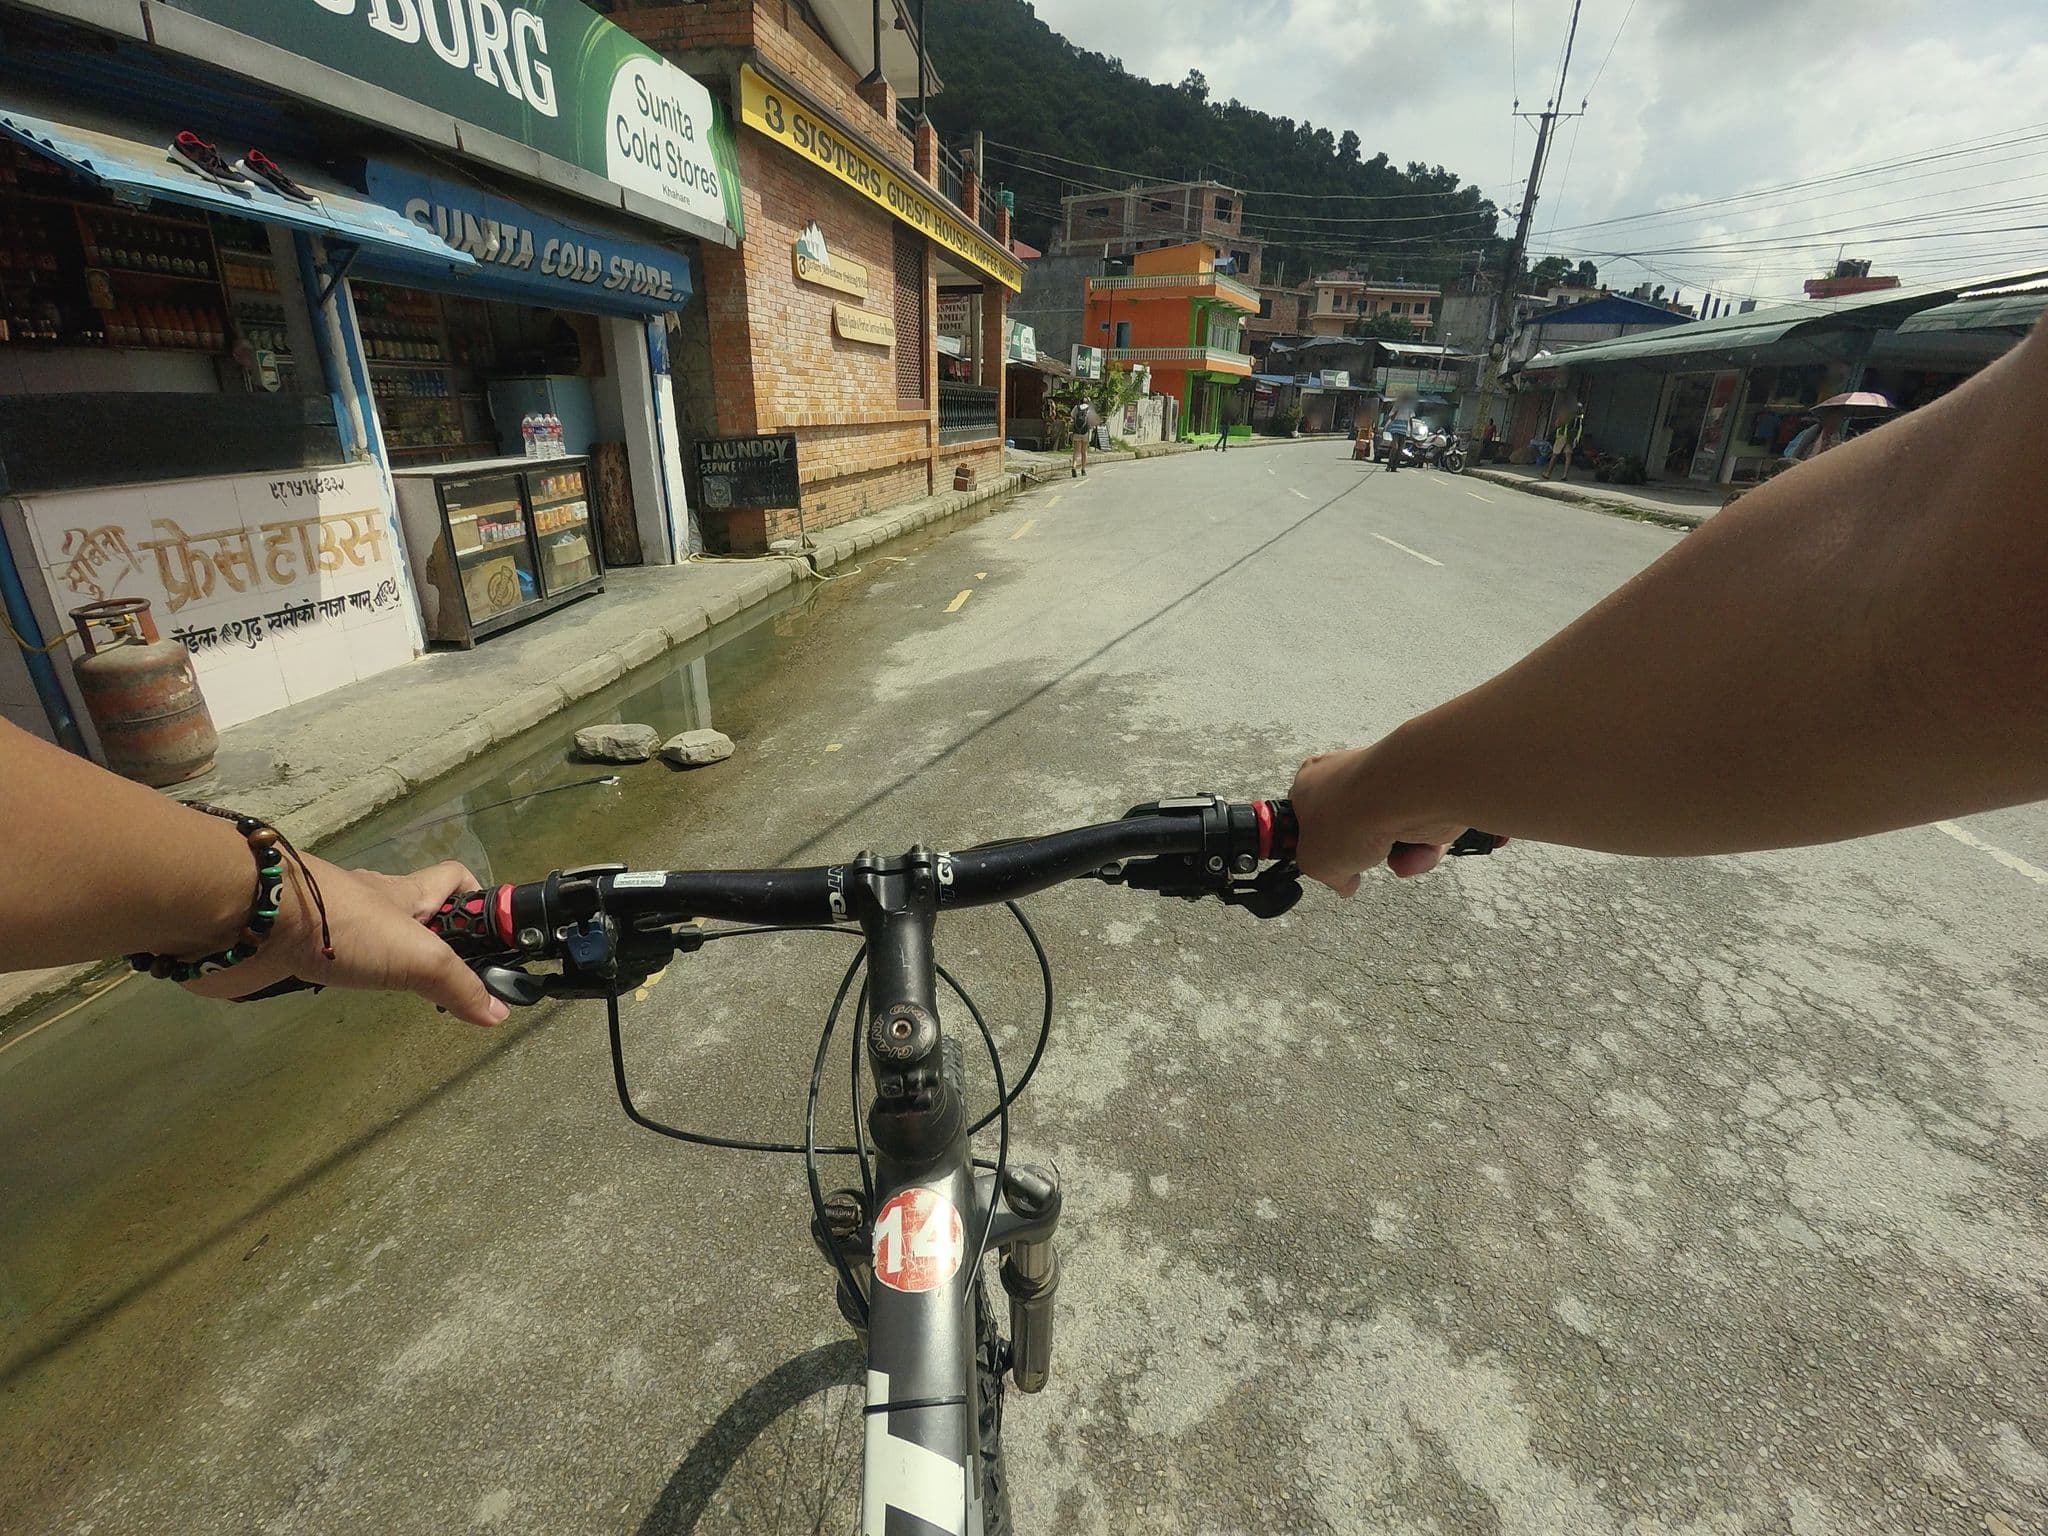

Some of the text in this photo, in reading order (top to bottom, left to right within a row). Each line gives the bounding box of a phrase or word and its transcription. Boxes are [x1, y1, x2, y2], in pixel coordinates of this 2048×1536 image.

[634, 73, 695, 144] Sunita
[616, 114, 719, 198] Cold Stores
[764, 94, 785, 134] 3
[793, 114, 882, 198] SISTERS
[887, 181, 931, 230] GUEST
[934, 214, 969, 255] HOUSE
[975, 242, 999, 274] COFFEE
[999, 261, 1014, 283] SHOP
[405, 197, 536, 270] SUNITA
[540, 238, 603, 284] COLD
[798, 255, 807, 276] 3
[700, 439, 788, 464] LAUNDRY
[700, 460, 737, 474] SERVICE
[318, 595, 346, 619] ताजा
[873, 1196, 958, 1275] 14
